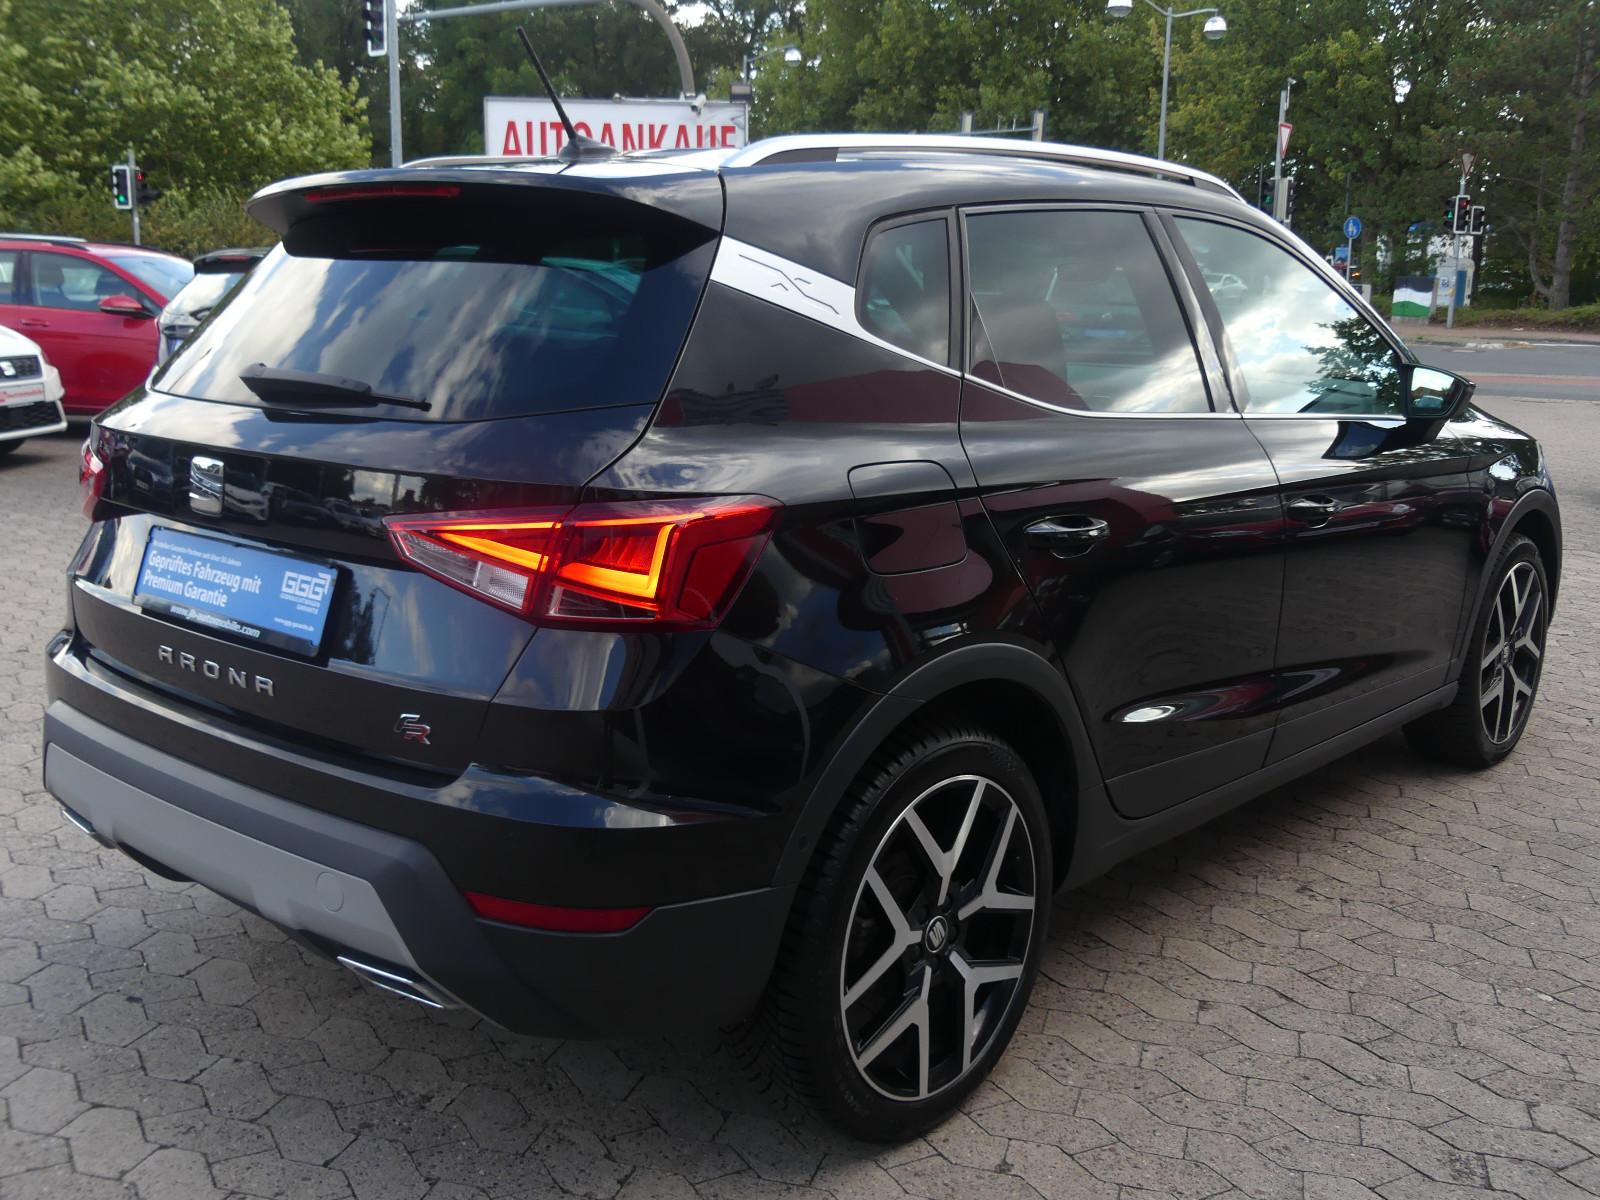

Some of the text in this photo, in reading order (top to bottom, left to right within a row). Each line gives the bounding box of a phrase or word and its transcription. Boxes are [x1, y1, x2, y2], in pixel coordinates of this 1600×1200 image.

[143, 569, 228, 607] Premium Garantie
[148, 550, 193, 576] Geprüftes
[193, 561, 240, 591] Fahrzeug
[241, 575, 262, 594] mit
[158, 645, 275, 697] ARONA
[394, 713, 431, 745] FR
